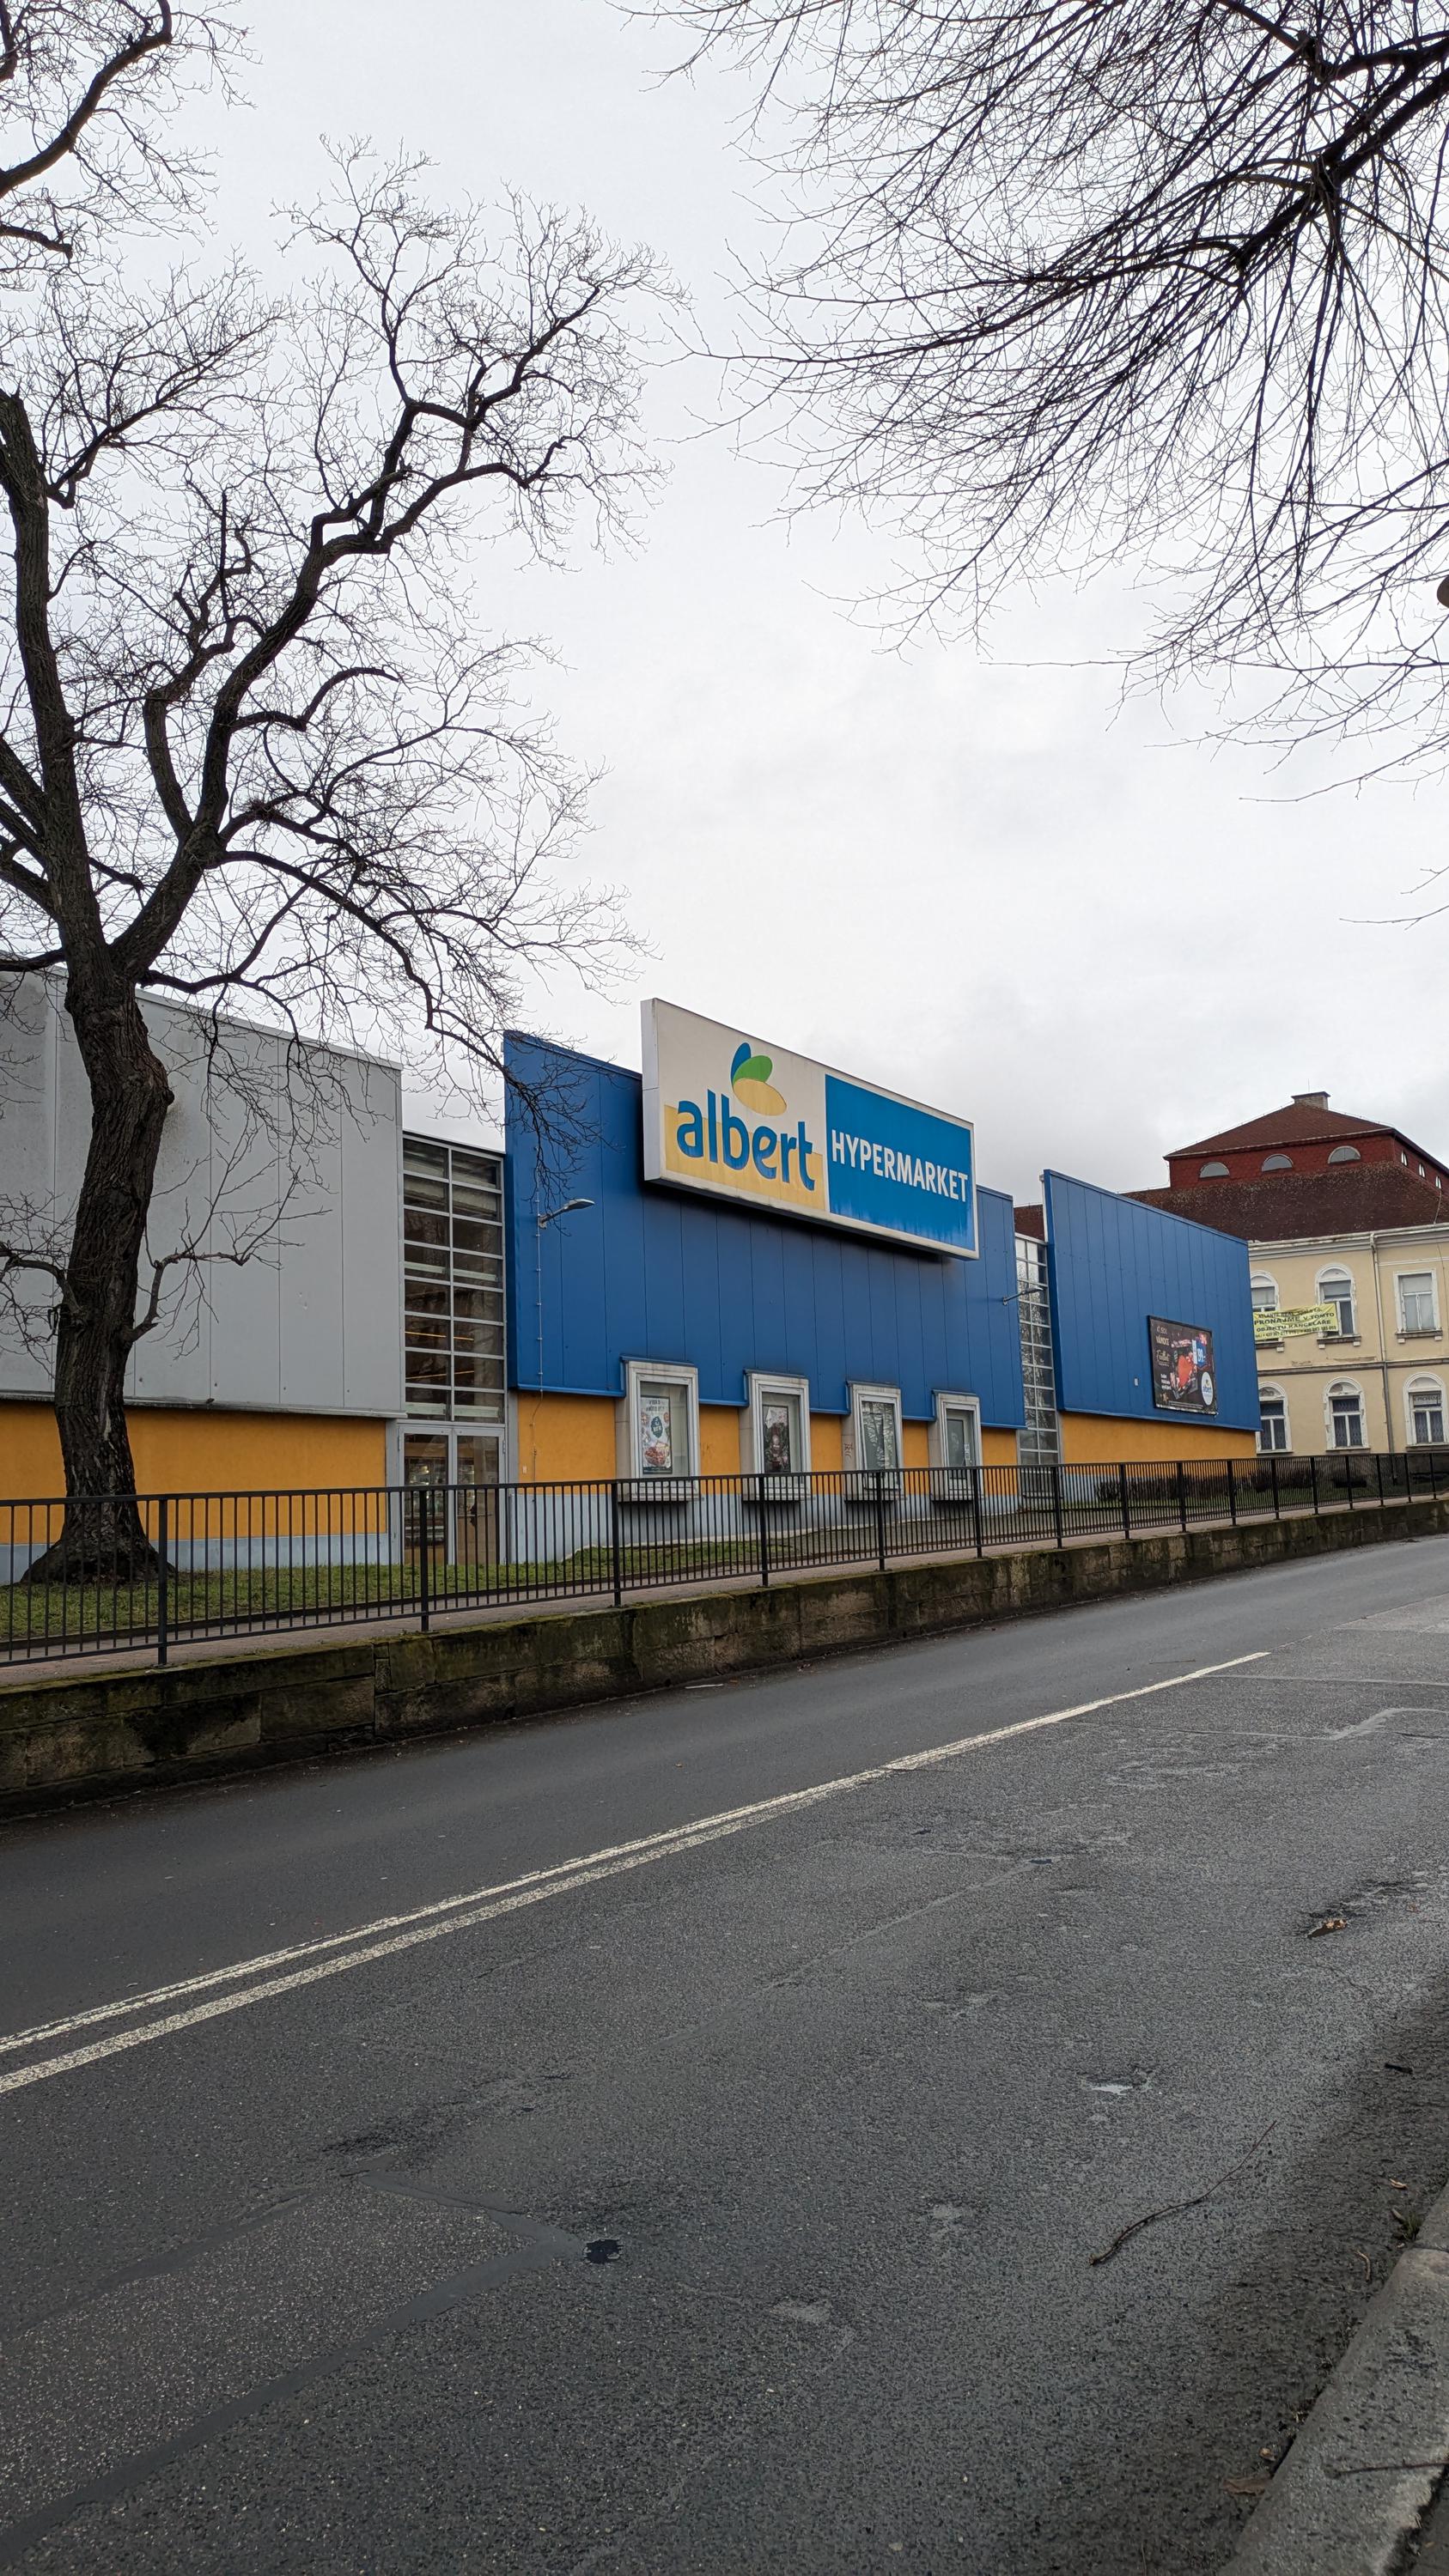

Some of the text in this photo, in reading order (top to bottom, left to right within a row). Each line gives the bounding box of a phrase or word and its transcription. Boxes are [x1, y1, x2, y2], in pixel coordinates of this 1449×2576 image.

[677, 1089, 815, 1191] albert
[831, 1129, 968, 1202] HYPERMARKET
[1254, 1316, 1300, 1325] PRONAJME
